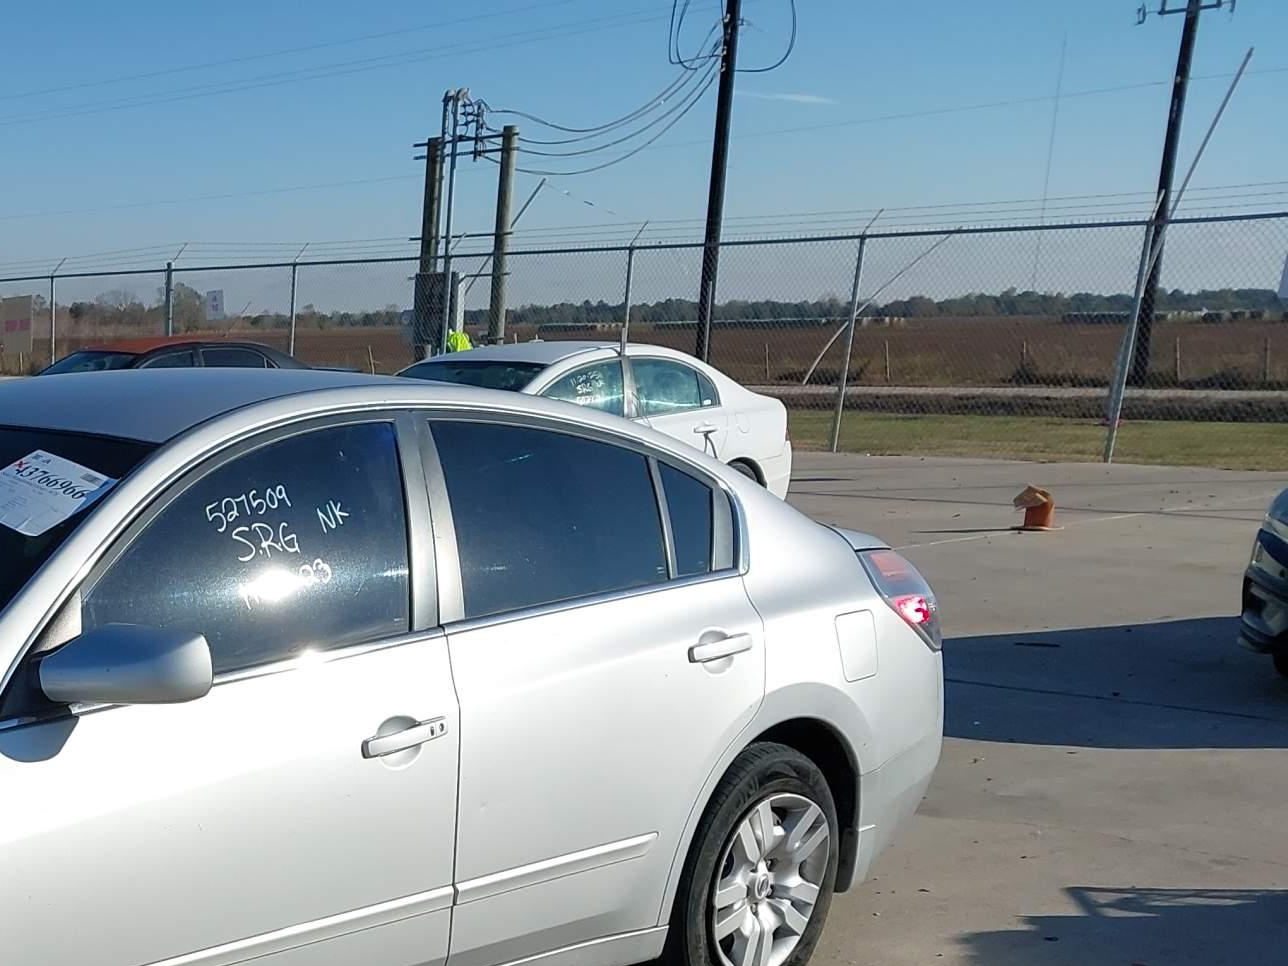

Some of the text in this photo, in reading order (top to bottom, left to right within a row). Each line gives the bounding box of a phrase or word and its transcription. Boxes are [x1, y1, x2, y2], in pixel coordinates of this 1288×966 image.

[15, 462, 91, 500] 43766966
[205, 485, 292, 533] 527509
[316, 500, 350, 533] NK
